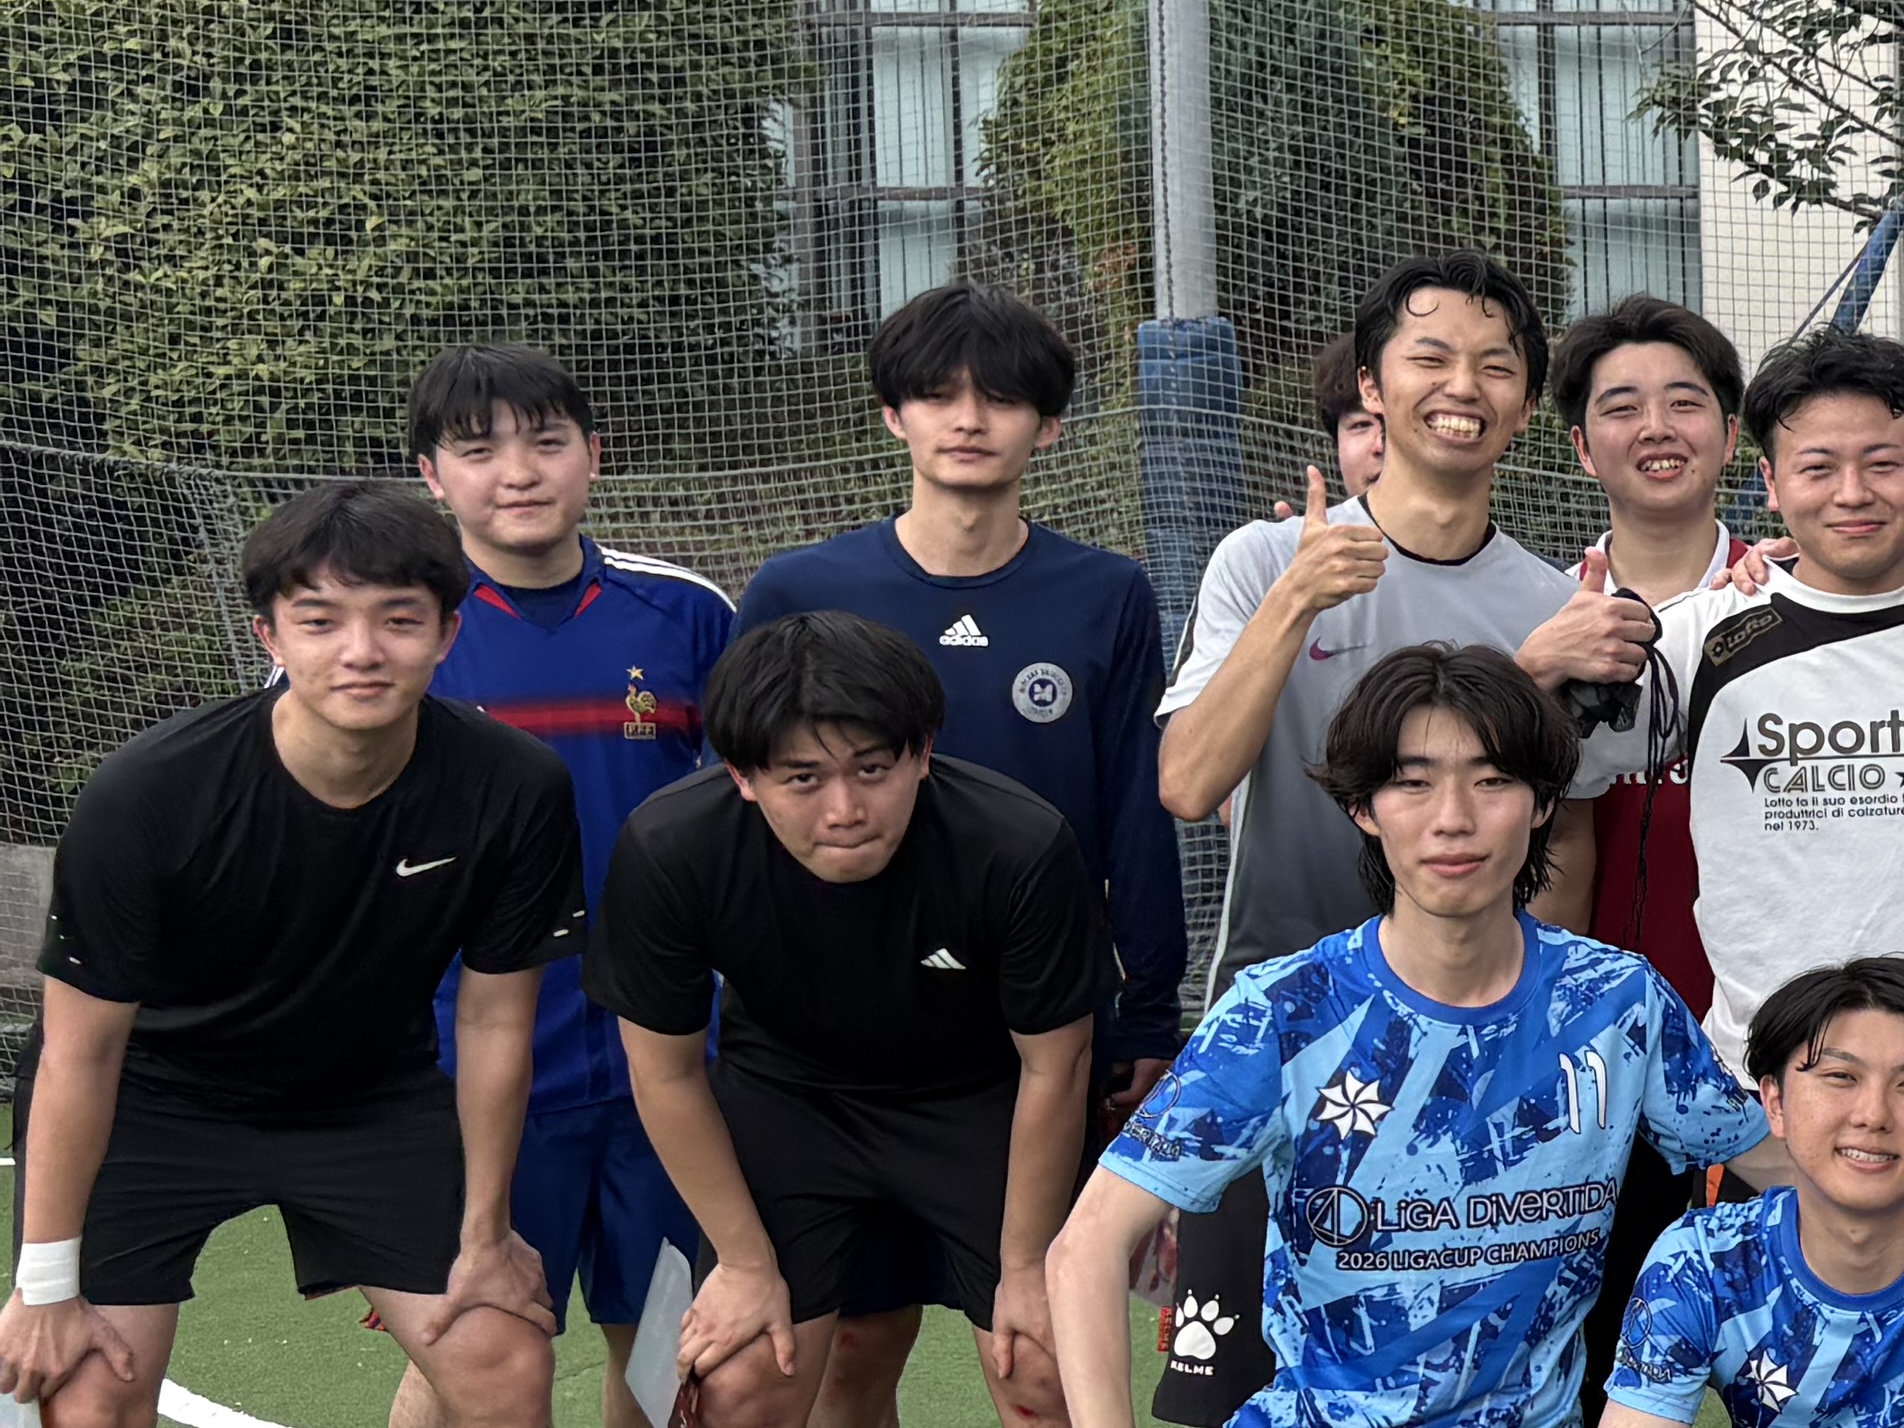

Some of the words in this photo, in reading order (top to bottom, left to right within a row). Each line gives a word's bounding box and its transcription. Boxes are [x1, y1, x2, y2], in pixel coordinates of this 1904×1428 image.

[1763, 764, 1885, 793] CALCIO
[1764, 797, 1793, 808] Lotto
[1822, 797, 1846, 806] suo
[1850, 794, 1898, 805] esordio
[1832, 806, 1844, 818] di
[1788, 820, 1819, 832] 1973.
[1558, 1050, 1607, 1134] 11
[1338, 1251, 1387, 1270] 2026
[1392, 1247, 1483, 1270] LIGACUP
[1487, 1231, 1599, 1263] CHAMPIONS
[1170, 1360, 1214, 1376] KELME
